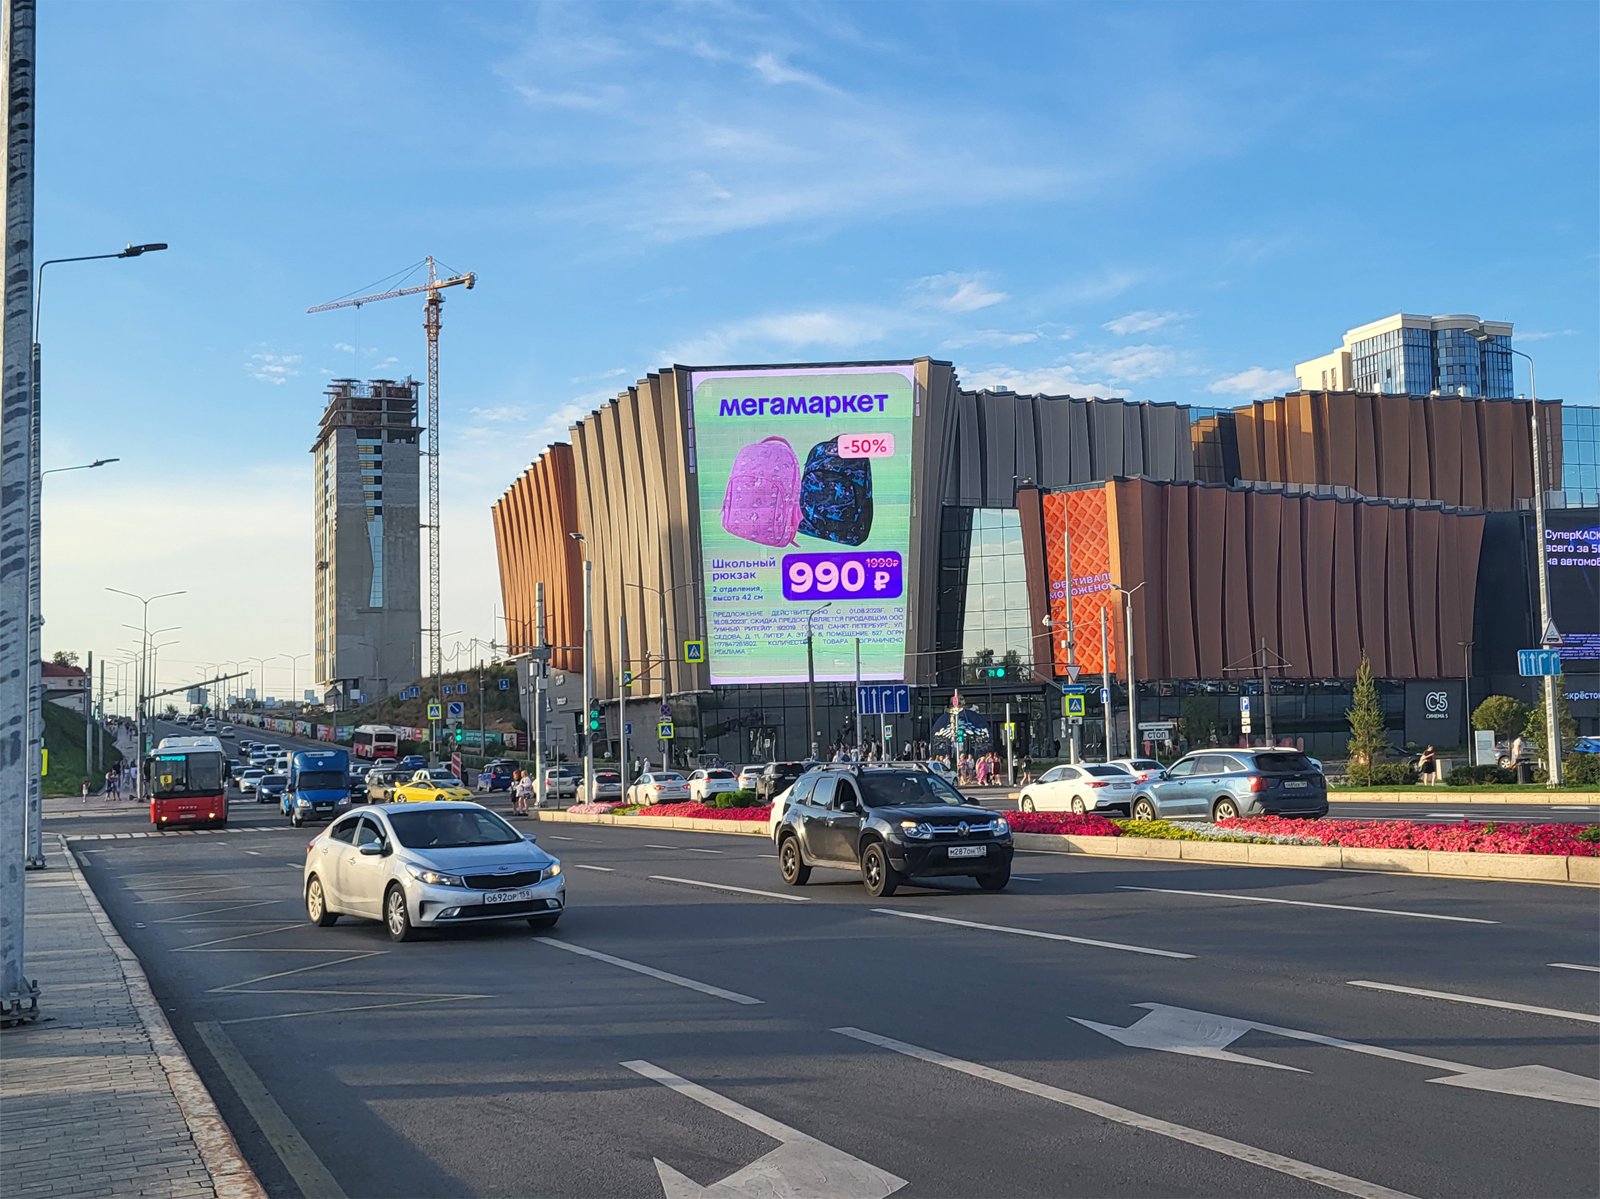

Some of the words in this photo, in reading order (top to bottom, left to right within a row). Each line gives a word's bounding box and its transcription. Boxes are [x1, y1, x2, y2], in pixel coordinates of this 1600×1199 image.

[719, 394, 889, 418] мегамаркет
[843, 438, 887, 453] -50%
[1576, 545, 1589, 553] за
[712, 556, 776, 569] Школьный
[712, 571, 757, 582] рюкзак
[788, 560, 866, 593] 990
[874, 571, 890, 591] ₽
[719, 585, 763, 593] отделения,
[1147, 731, 1166, 739] СТОП
